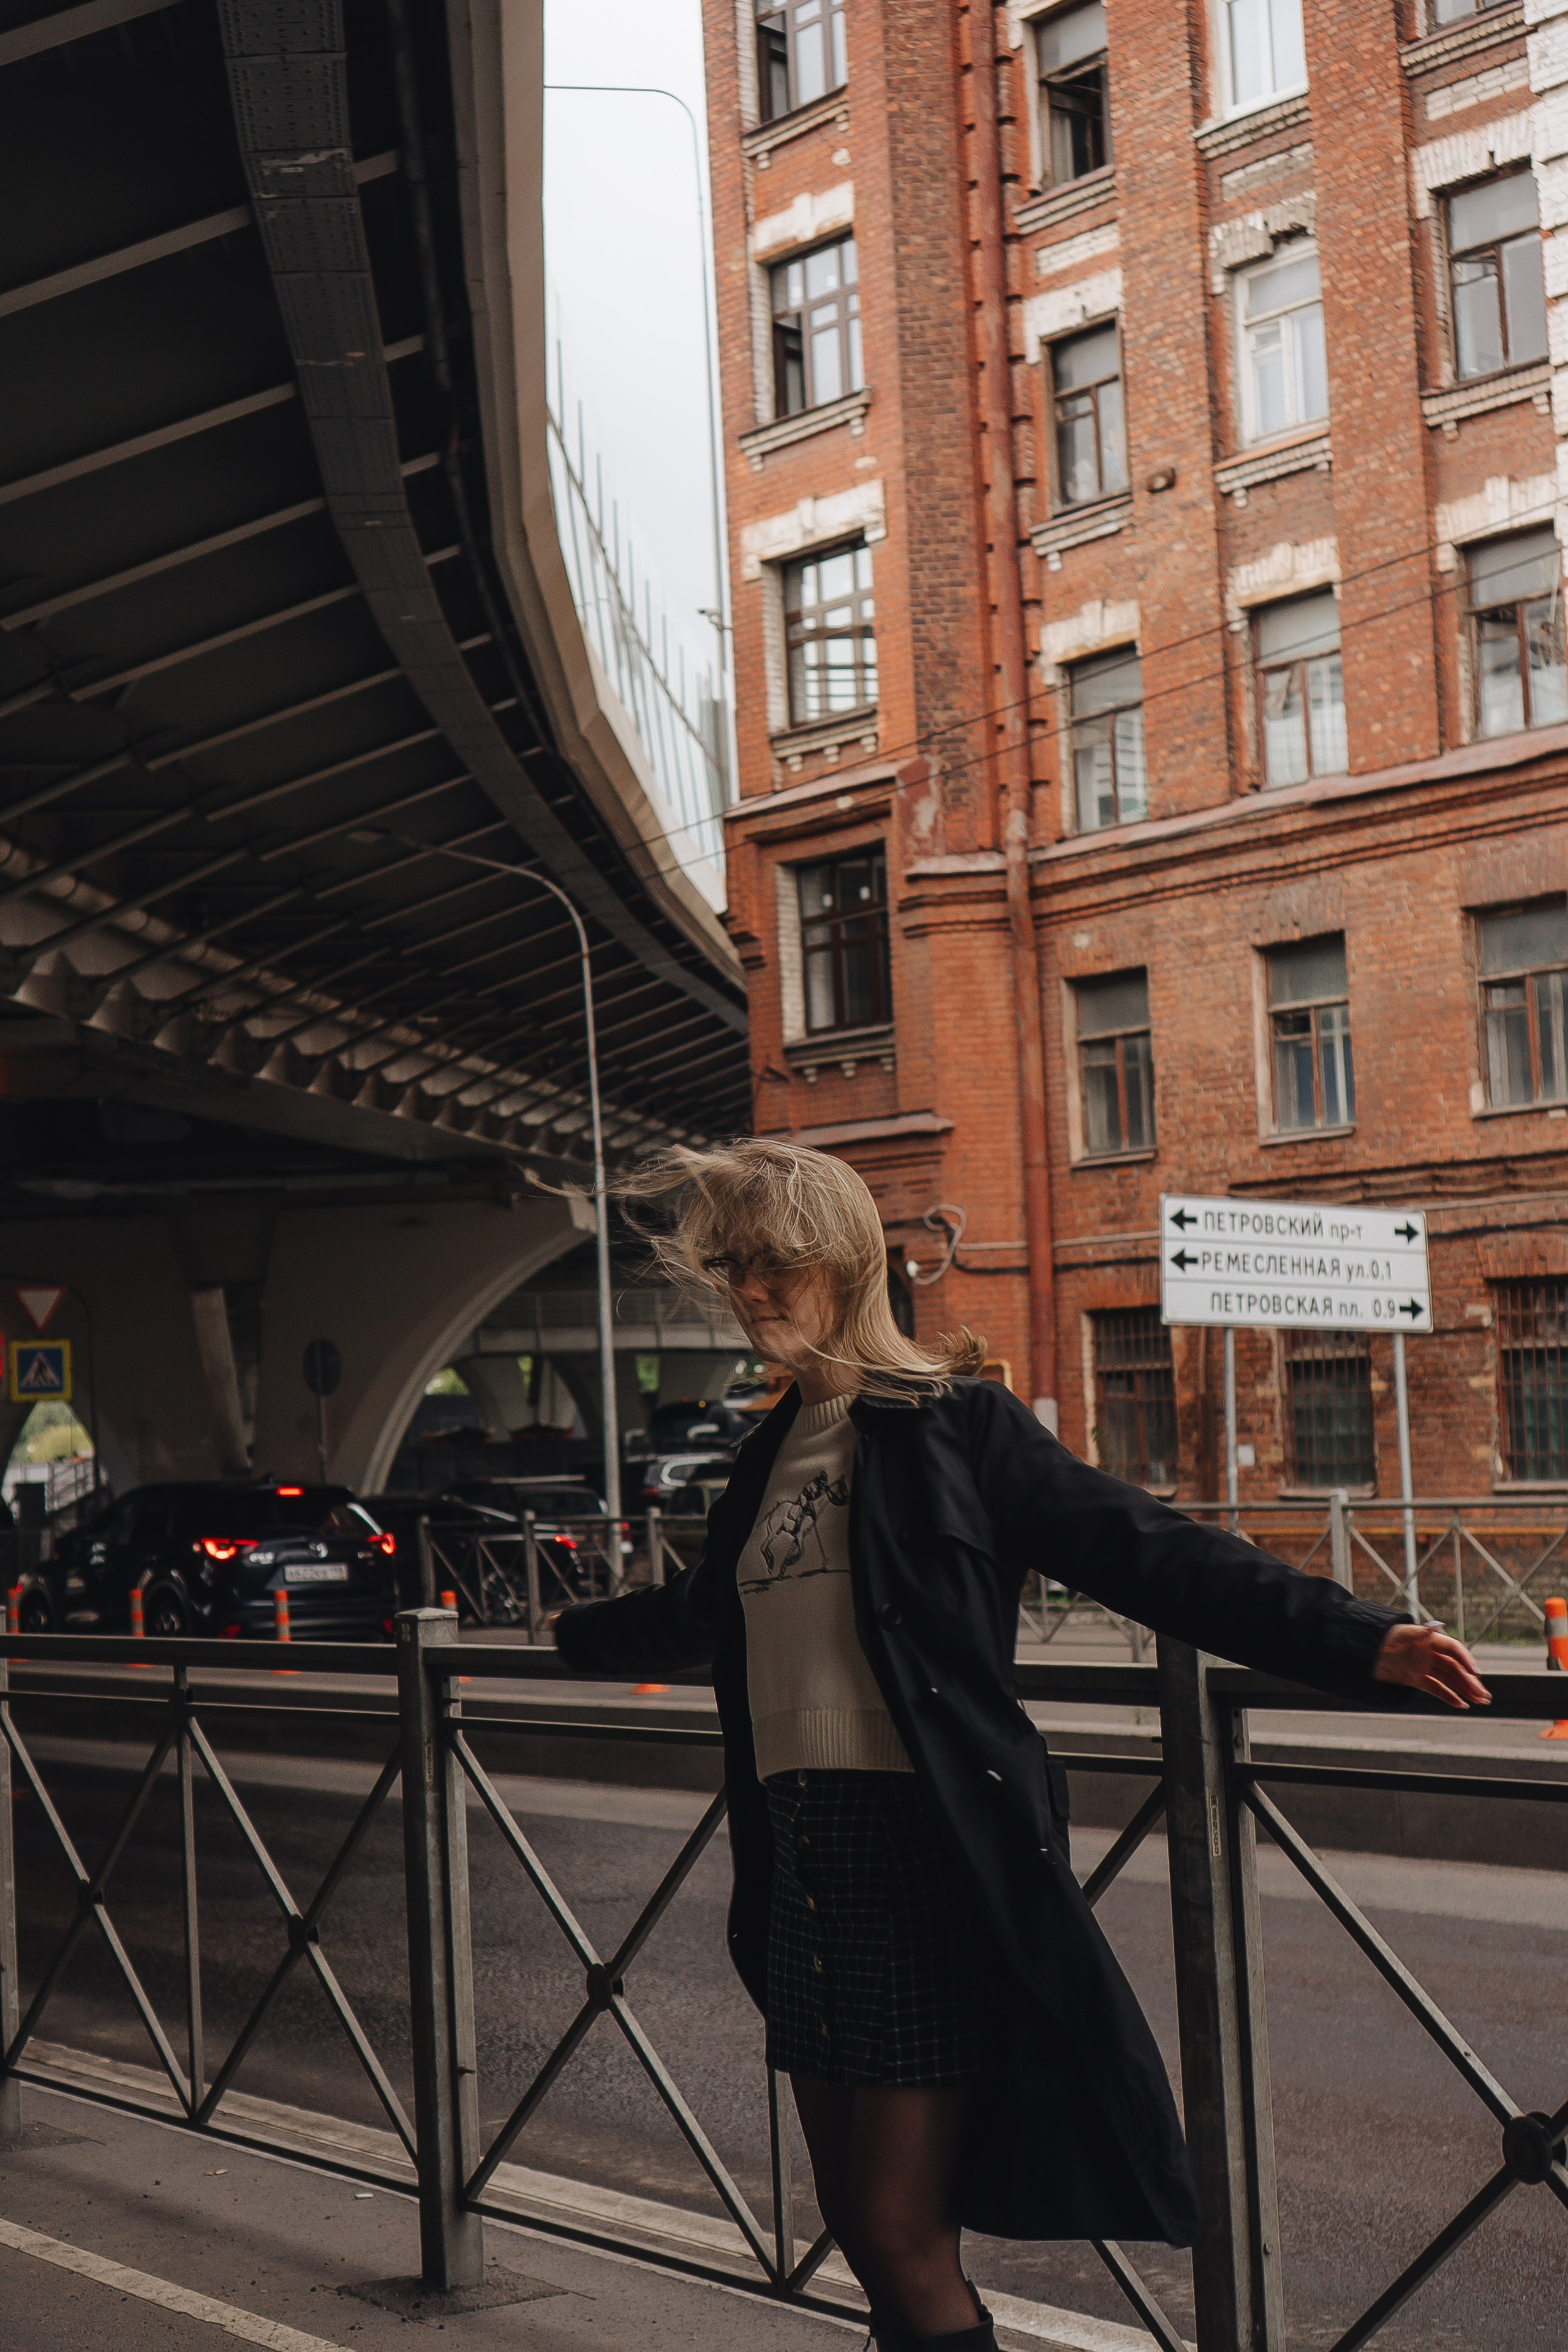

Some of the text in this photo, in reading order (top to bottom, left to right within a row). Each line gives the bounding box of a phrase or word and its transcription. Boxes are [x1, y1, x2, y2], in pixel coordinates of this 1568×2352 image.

[1204, 1211, 1362, 1243] ПЕТРОВСКИЙ пр-т
[1202, 1251, 1341, 1277] РЕМЕСЛЕННАЯ
[1212, 1291, 1333, 1315] ПЕТРОВСКАЯ
[1339, 1302, 1363, 1317] пл.
